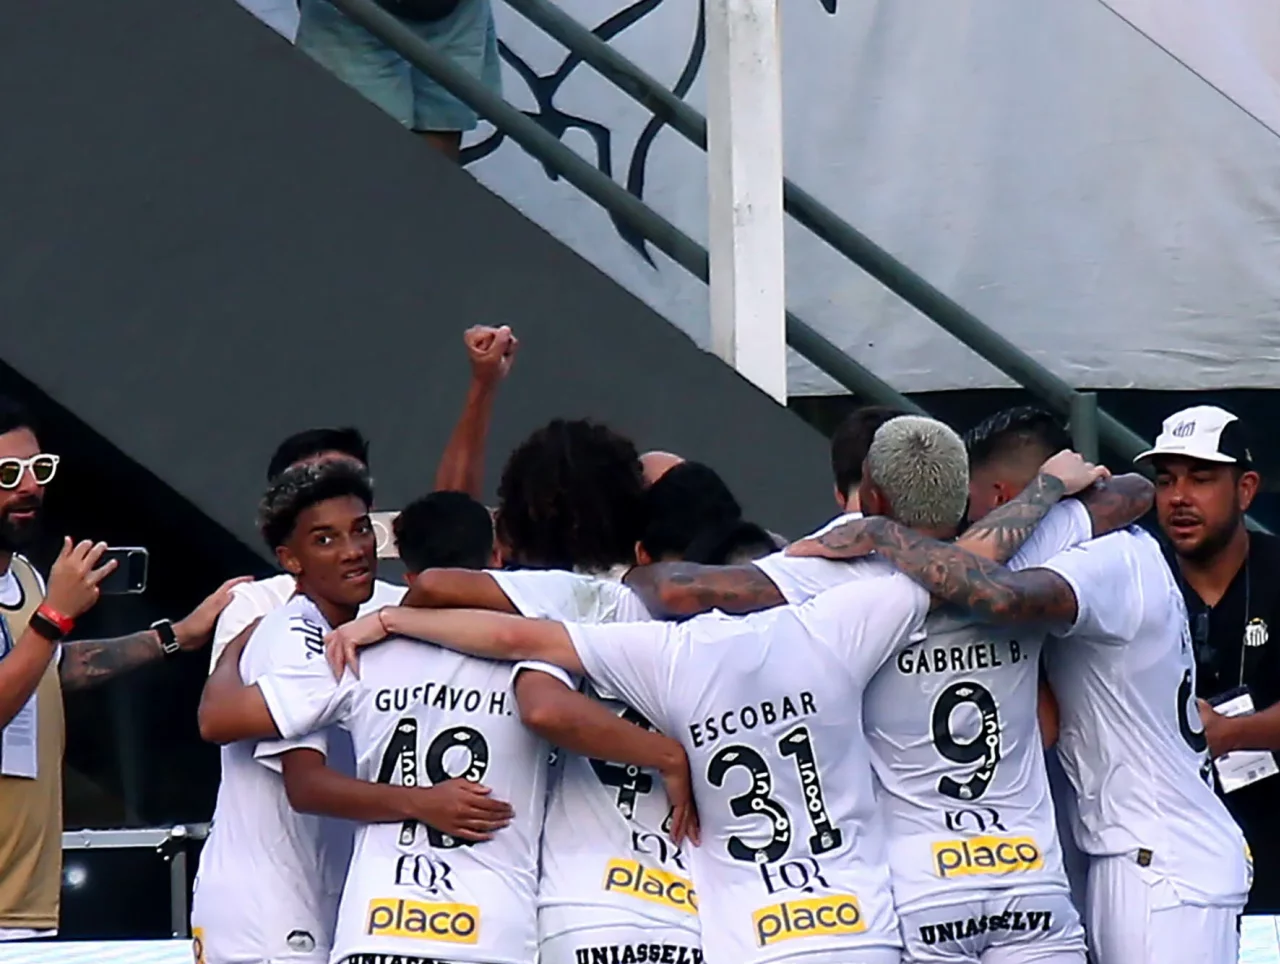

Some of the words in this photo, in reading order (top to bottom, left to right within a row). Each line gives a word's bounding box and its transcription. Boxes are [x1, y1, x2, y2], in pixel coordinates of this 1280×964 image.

[897, 644, 1002, 674] GABRIEL
[689, 691, 817, 748] ESCOBAR
[933, 682, 998, 800] 9
[707, 726, 842, 863] 31
[936, 841, 1039, 876] placo
[368, 900, 476, 936] placo
[756, 901, 861, 946] placo
[919, 911, 1052, 945] UNIASSELVI
